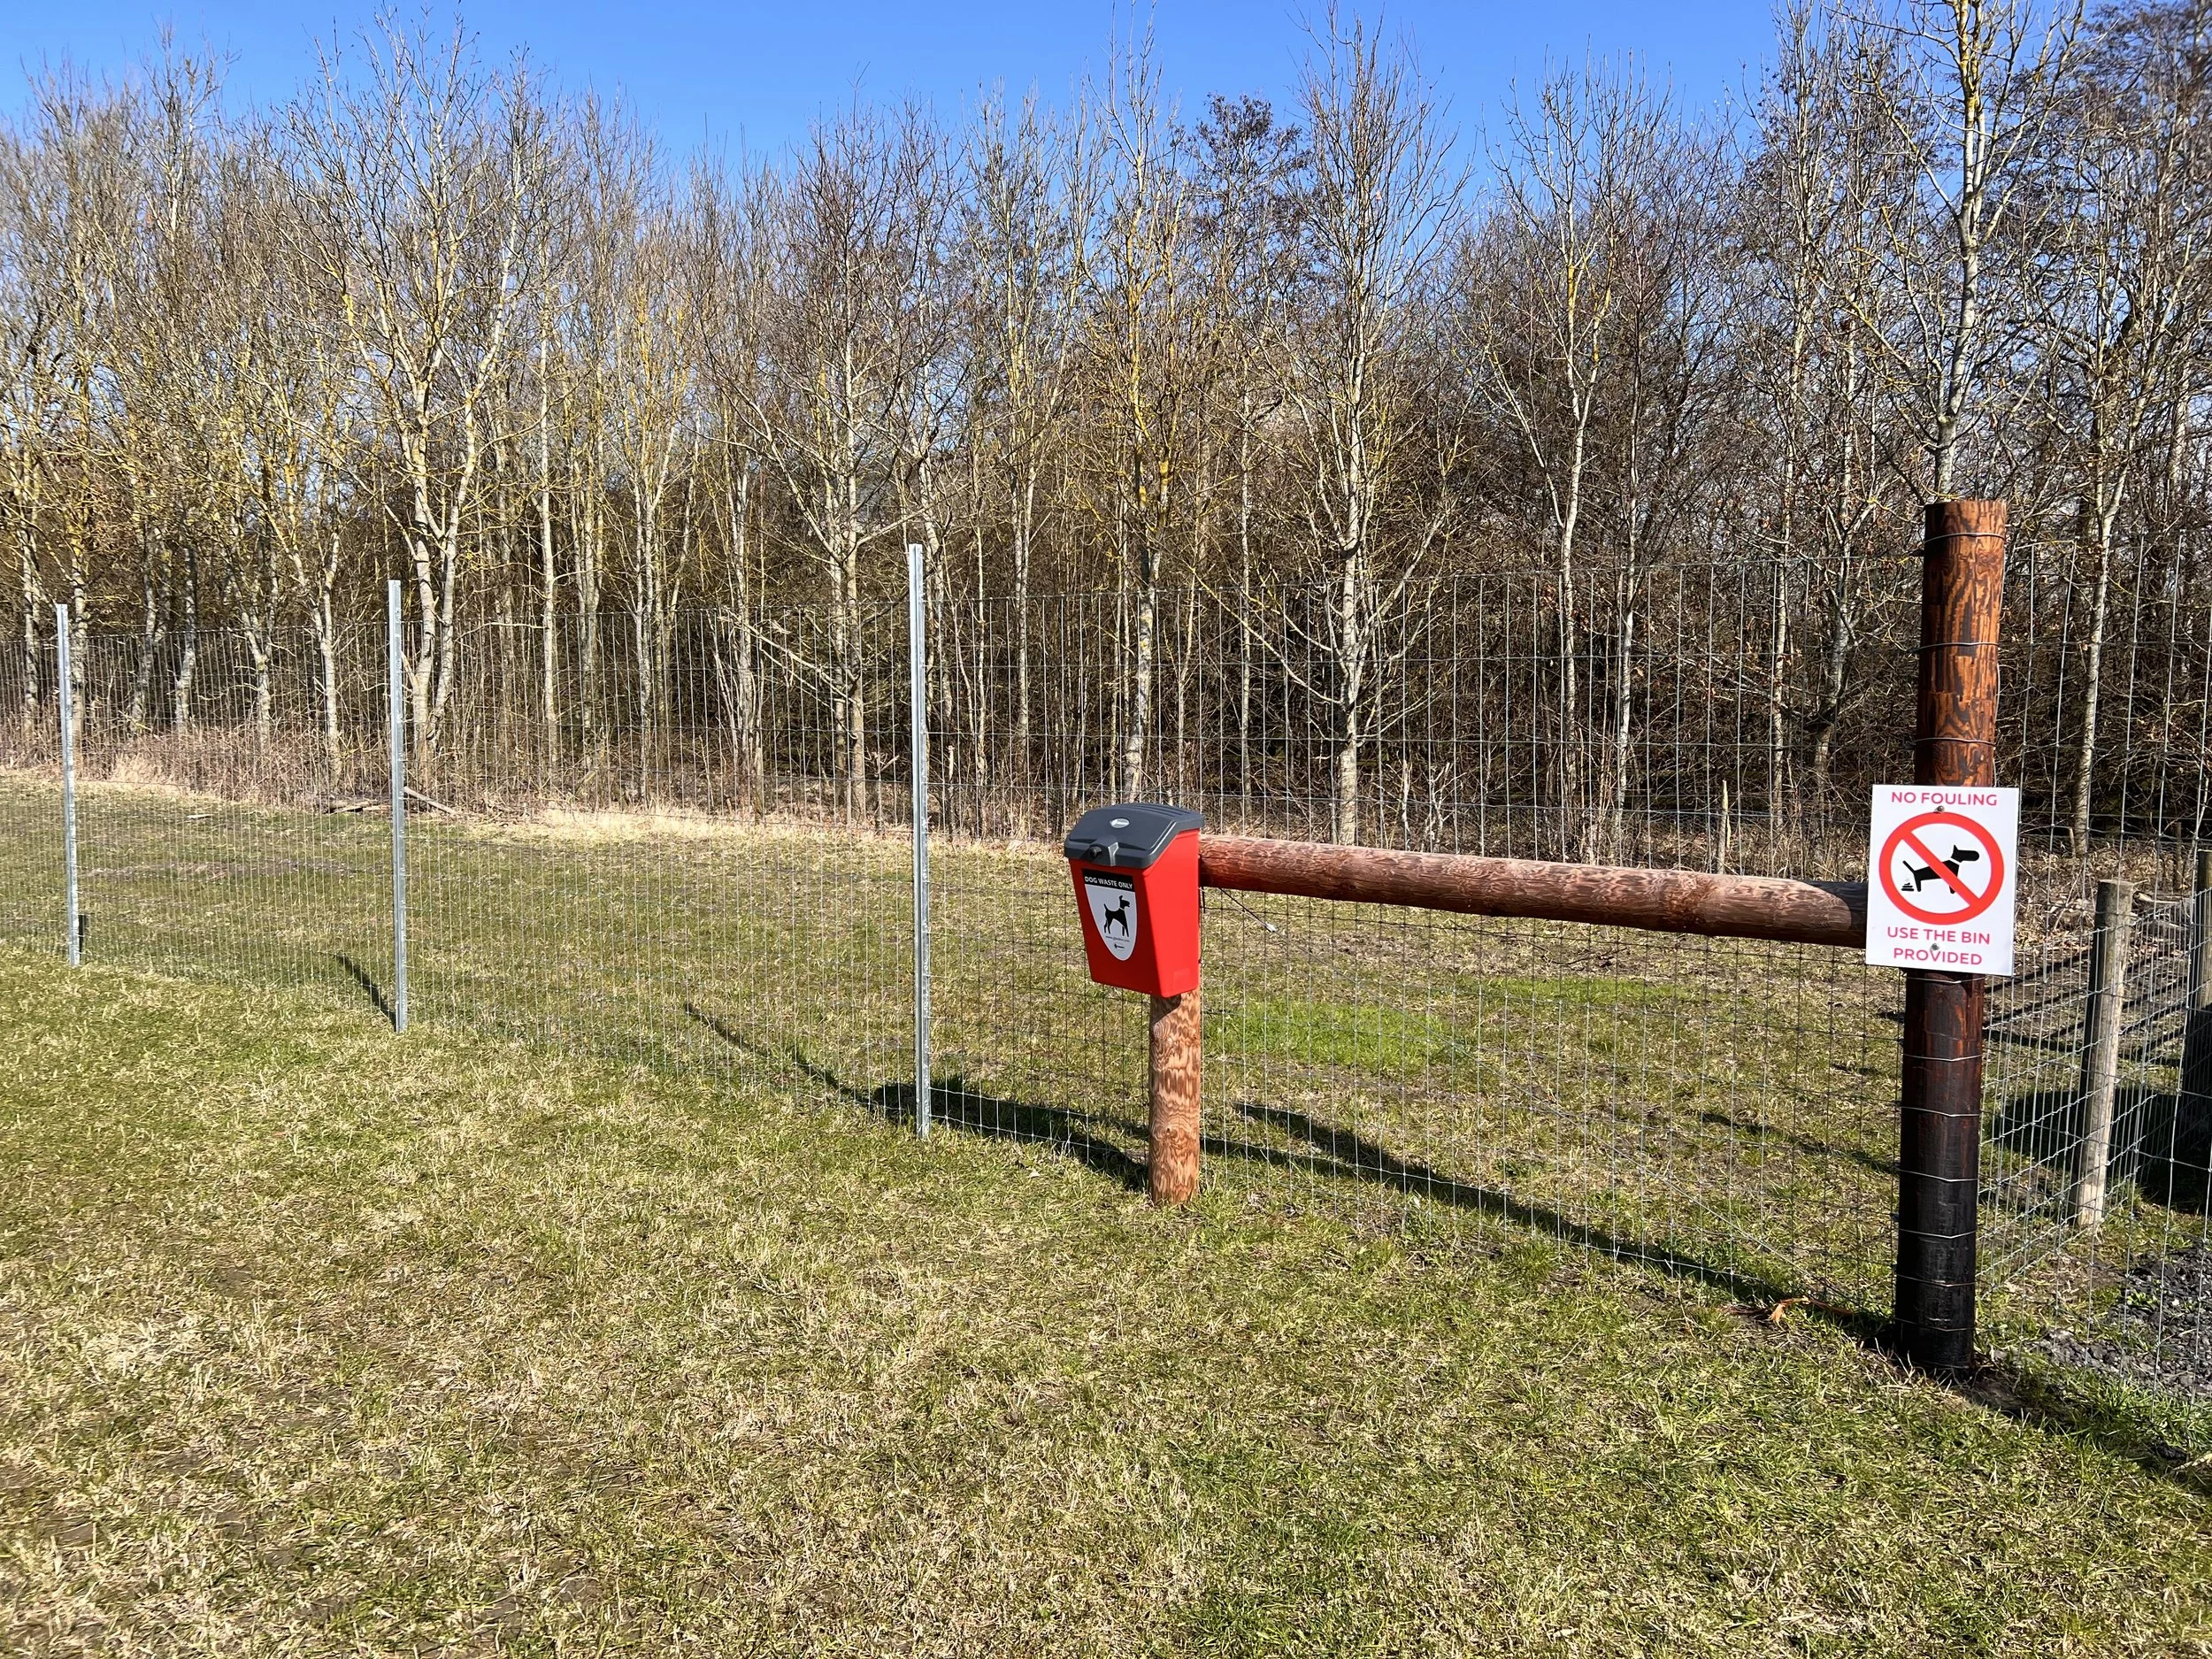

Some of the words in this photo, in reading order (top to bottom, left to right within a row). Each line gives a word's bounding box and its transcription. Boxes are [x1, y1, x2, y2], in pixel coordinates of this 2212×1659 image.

[1891, 792, 1916, 803] NO
[1921, 792, 1998, 806] FOULING
[1887, 926, 1918, 939] USE
[1924, 928, 1956, 942] THE
[1961, 932, 1990, 945] BIN
[1893, 948, 1982, 965] PROVIDED
